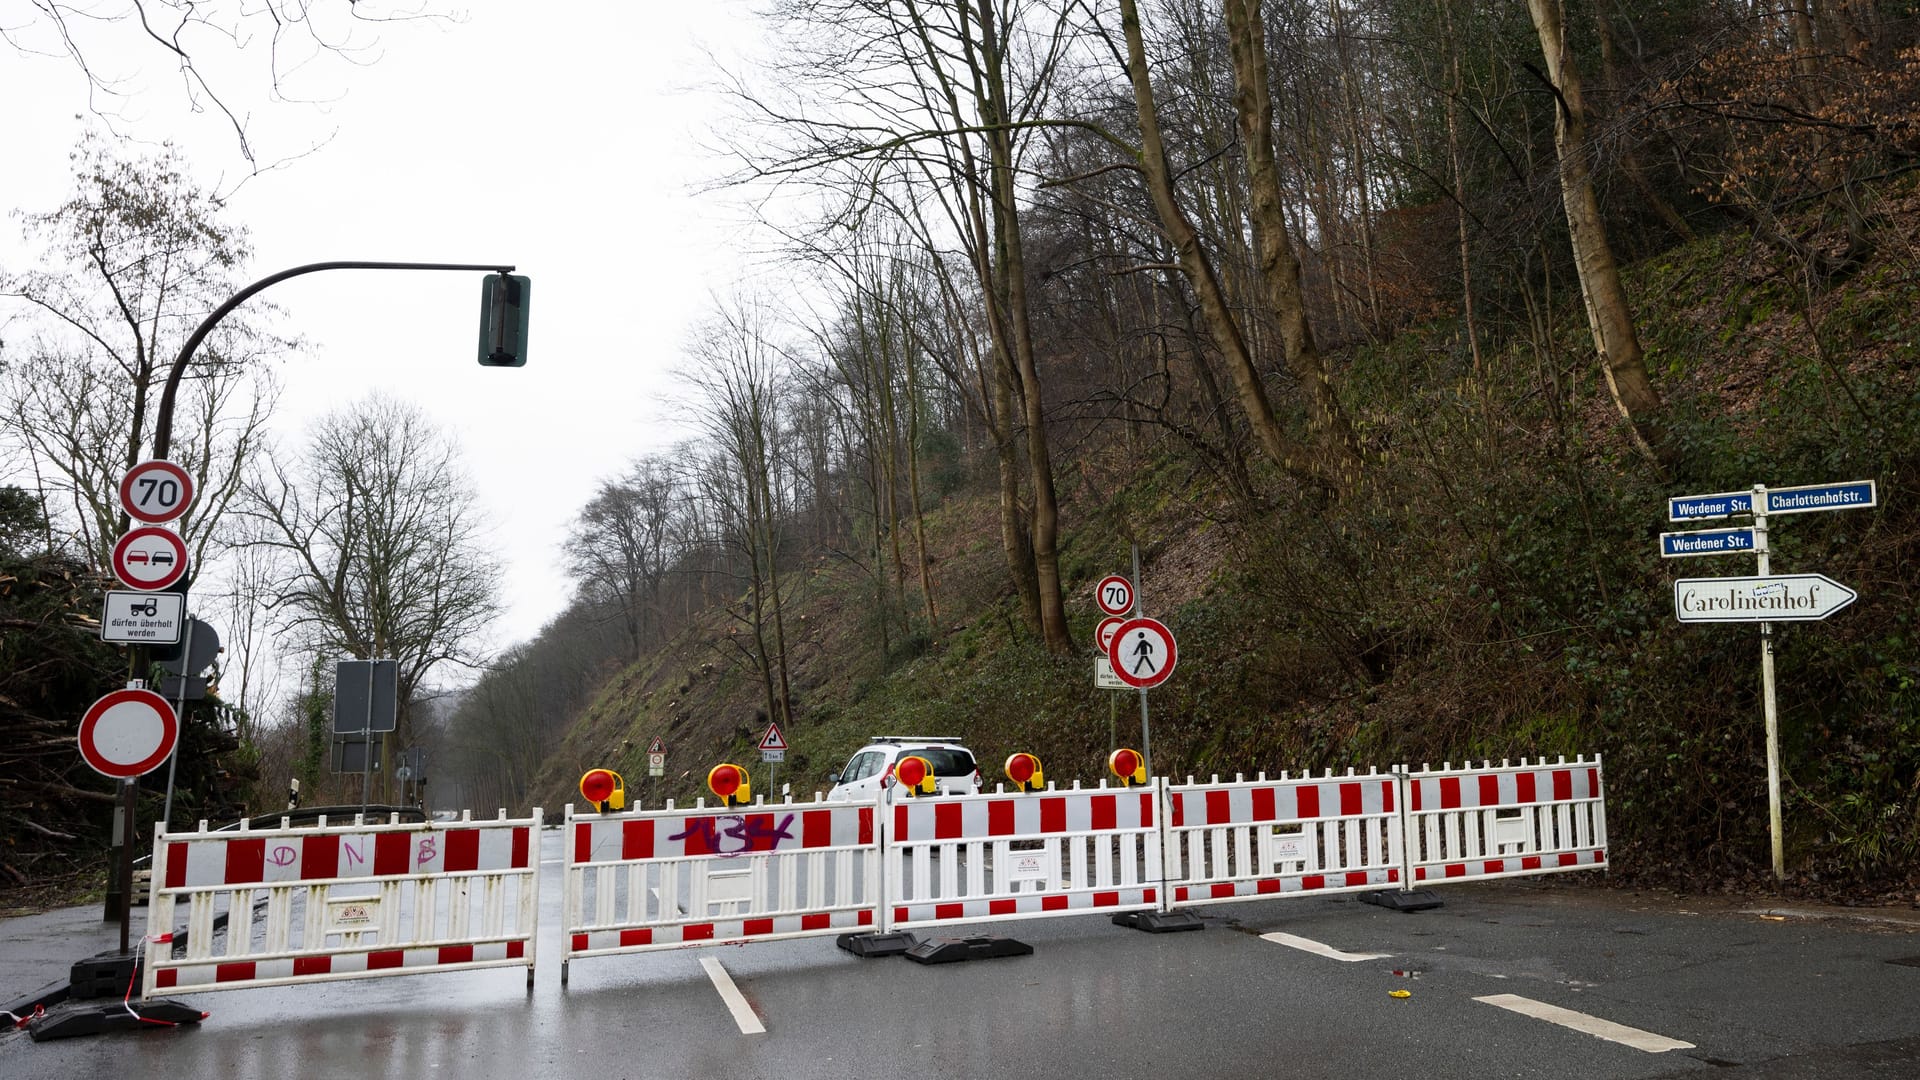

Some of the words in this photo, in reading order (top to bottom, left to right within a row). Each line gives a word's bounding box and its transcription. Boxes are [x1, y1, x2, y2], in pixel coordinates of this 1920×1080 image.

[139, 479, 178, 507] 70
[1772, 490, 1863, 508] Charlottenhofstr.
[1678, 502, 1726, 515] Werdener
[1731, 499, 1750, 512] Str.
[1672, 538, 1724, 552] Werdener
[1727, 535, 1749, 547] Str.
[1106, 587, 1126, 605] 70
[1682, 584, 1820, 612] Carolinenhof
[111, 618, 137, 628] dürfen
[140, 619, 172, 628] überholt
[127, 629, 156, 637] werden
